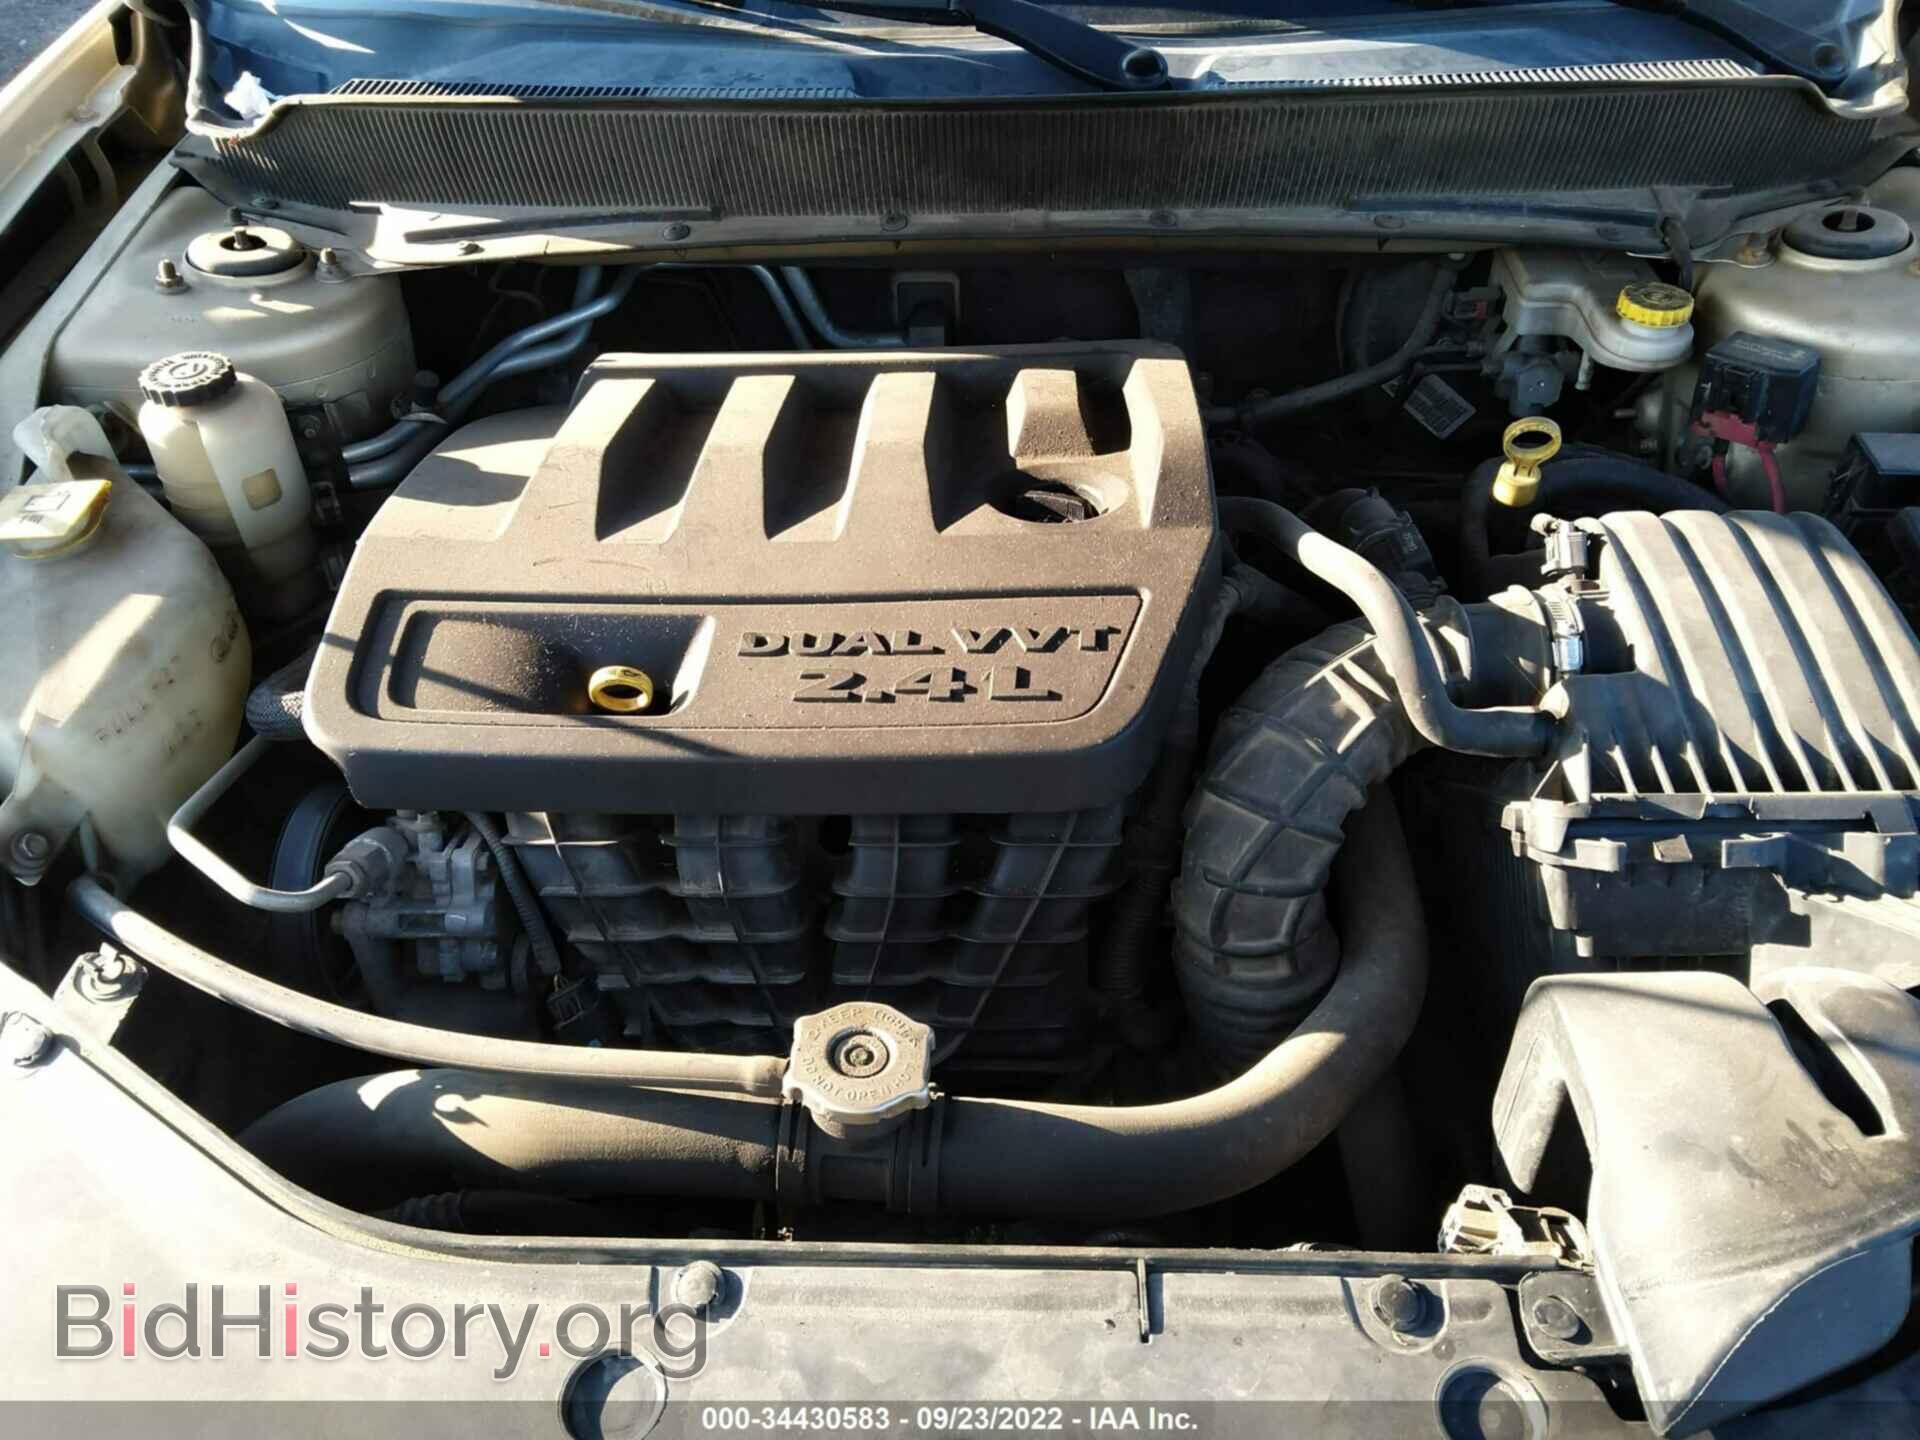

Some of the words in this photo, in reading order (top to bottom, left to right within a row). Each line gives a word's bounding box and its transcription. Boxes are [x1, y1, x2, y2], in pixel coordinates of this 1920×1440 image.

[738, 629, 945, 657] DUAL
[950, 626, 1121, 654] VVT
[793, 666, 1062, 703] 2.4L
